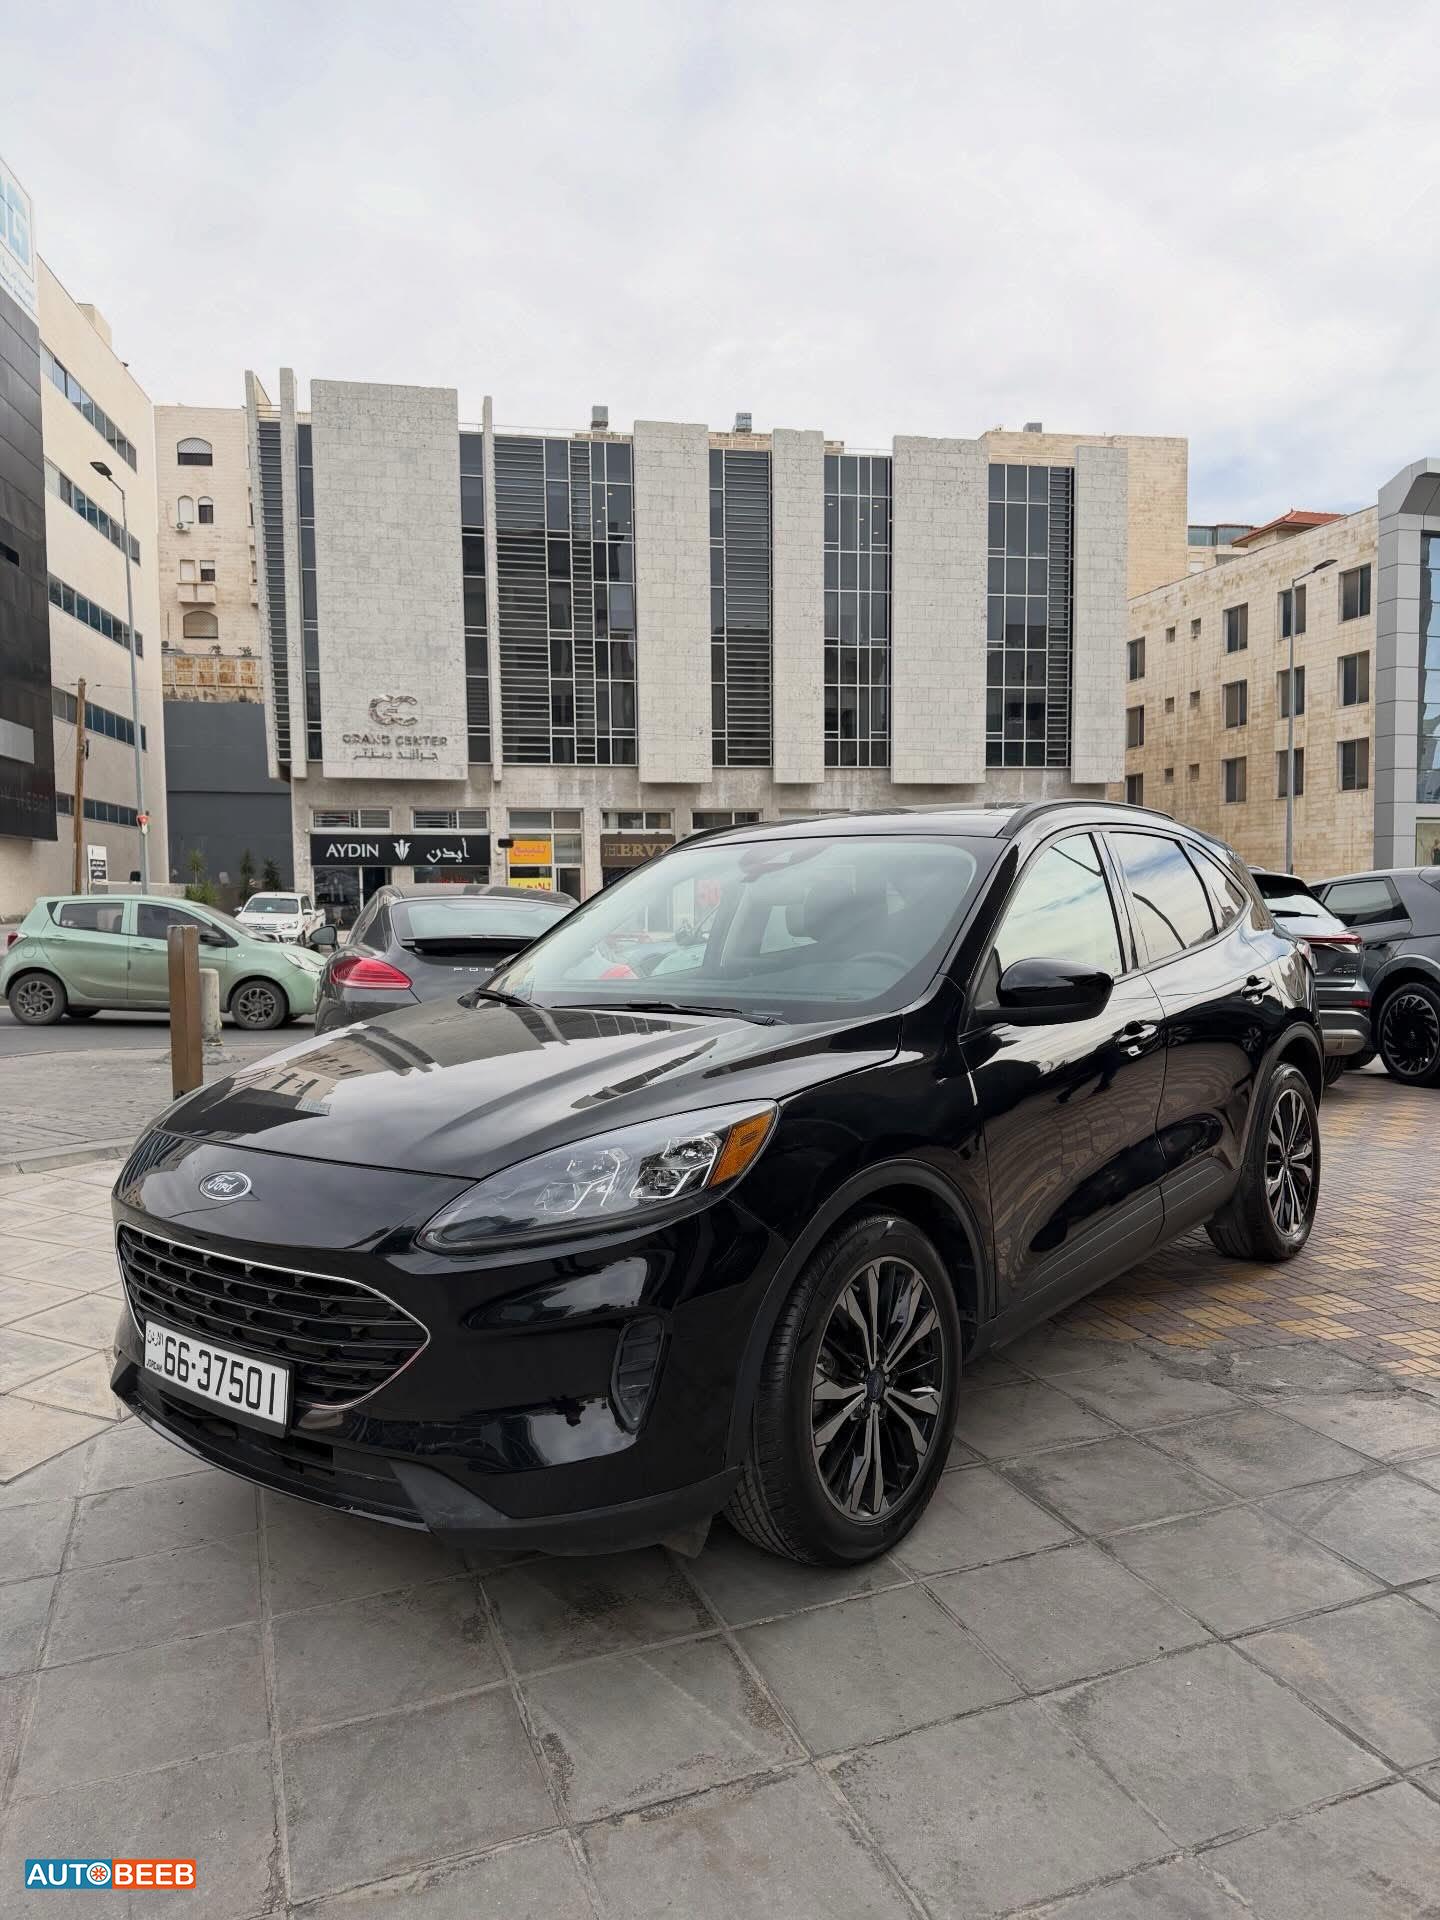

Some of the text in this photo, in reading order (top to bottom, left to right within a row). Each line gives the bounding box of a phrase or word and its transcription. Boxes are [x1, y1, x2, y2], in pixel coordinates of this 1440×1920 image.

[342, 734, 448, 746] GRAND CENTER
[326, 843, 379, 858] AYDIN
[207, 1174, 239, 1193] Ford
